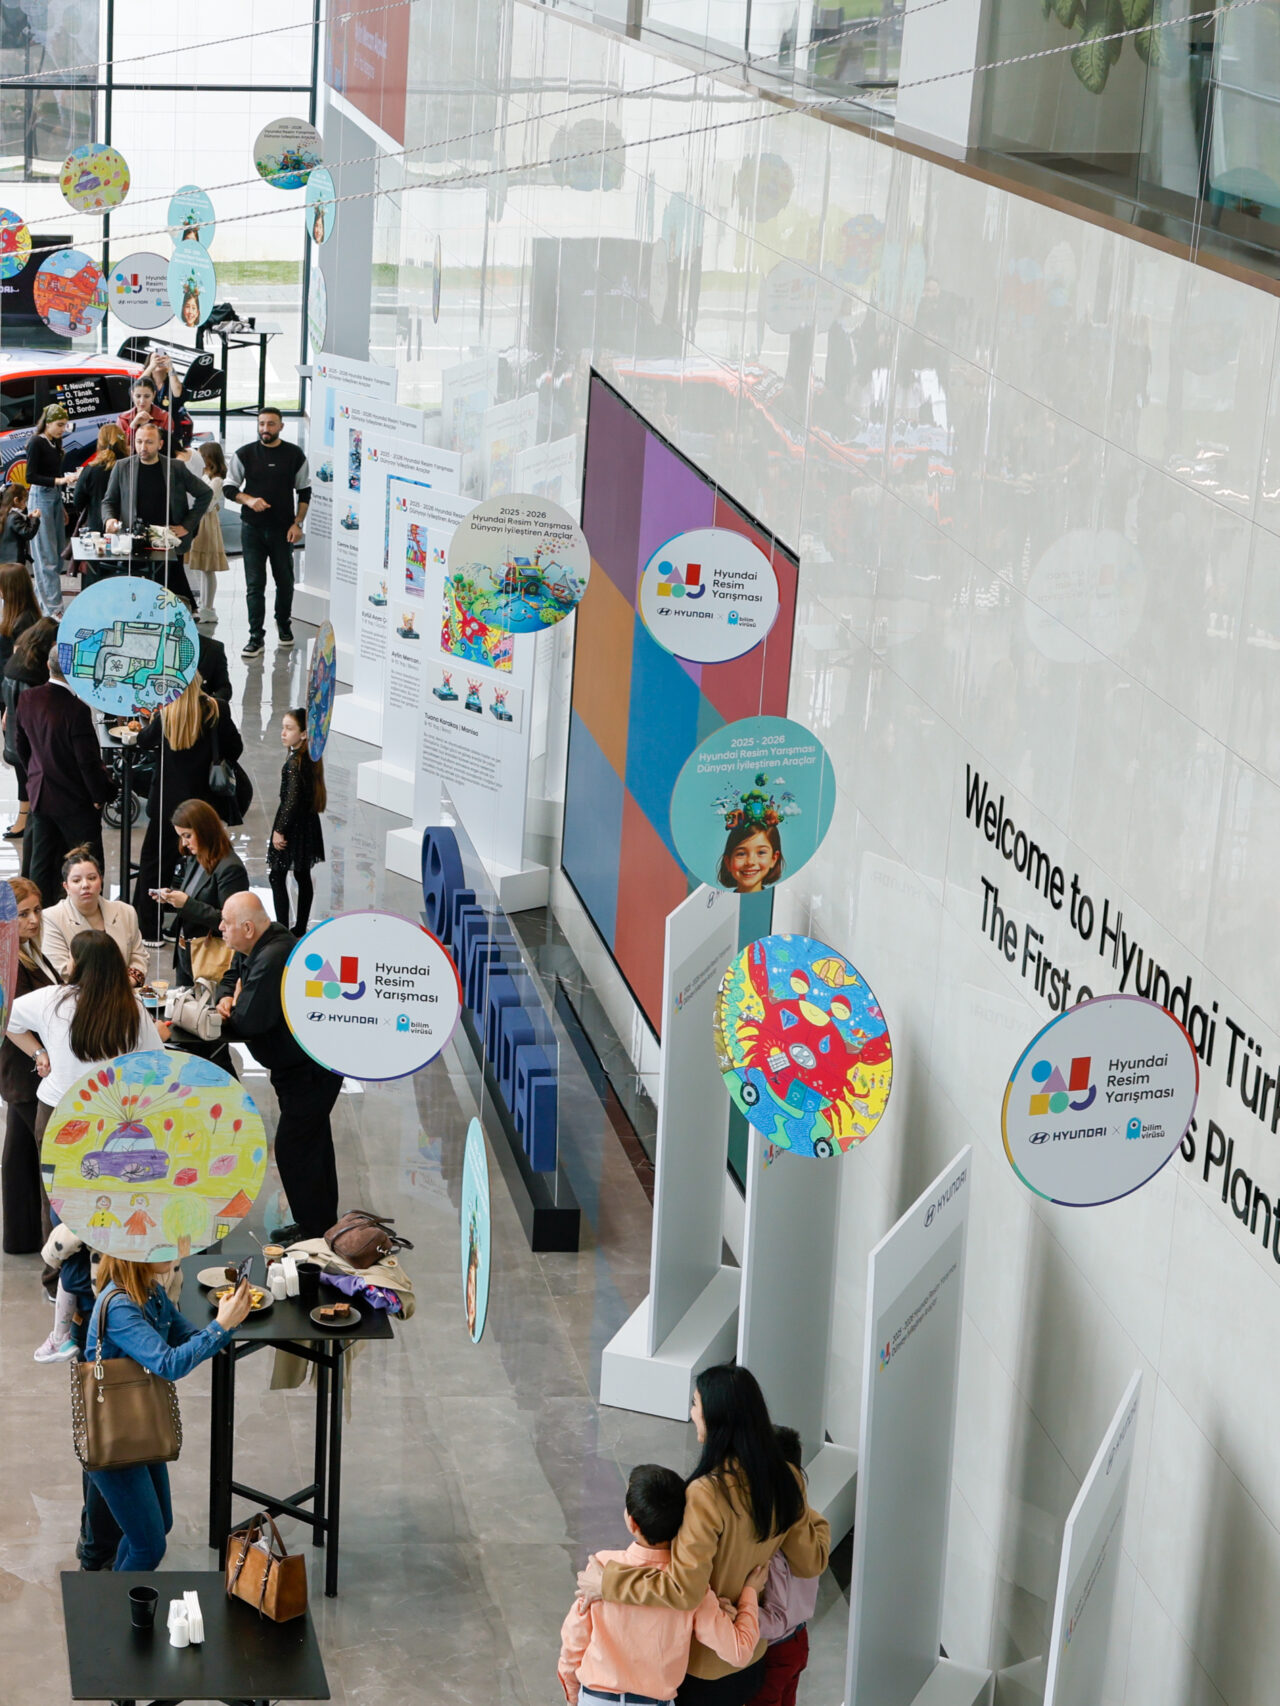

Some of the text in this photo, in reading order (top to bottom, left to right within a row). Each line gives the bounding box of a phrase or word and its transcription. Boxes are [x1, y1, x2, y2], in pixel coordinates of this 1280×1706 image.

[500, 507, 520, 516] 2025
[526, 510, 547, 519] 2026
[472, 514, 573, 530] Hyundai Resim Yarışması
[470, 522, 573, 540] Dünyayı İyileştiren Araçlar
[713, 569, 758, 581] Hyundai
[712, 579, 745, 590] Resim
[711, 590, 763, 603] Yarışması
[673, 609, 714, 619] HYUNDAI
[730, 737, 754, 748] 2025
[761, 735, 786, 745] 2026
[699, 744, 816, 762] Hyundai Resim Yarışması
[696, 755, 817, 774] Dünyayı İyileştiren Araçlar
[965, 762, 1065, 911] Welcome
[1070, 872, 1094, 941] to
[1098, 897, 1219, 1067] Hyundai
[980, 875, 1071, 1013] The First
[375, 962, 430, 976] Hyundai
[374, 975, 415, 988] Resim
[374, 988, 439, 1003] Yarışması
[328, 1013, 378, 1025] HYUNDAI
[410, 1021, 430, 1029] bilim
[410, 1027, 433, 1035] virüsü
[1108, 1053, 1169, 1073] Hyundai
[1106, 1072, 1150, 1088] Resim
[1105, 1088, 1175, 1104] Yarışması
[1052, 1126, 1107, 1141] HYUNDAI
[1141, 1124, 1162, 1132] bilim
[1141, 1130, 1165, 1140] virüsü
[936, 1167, 968, 1213] HYUNDAI
